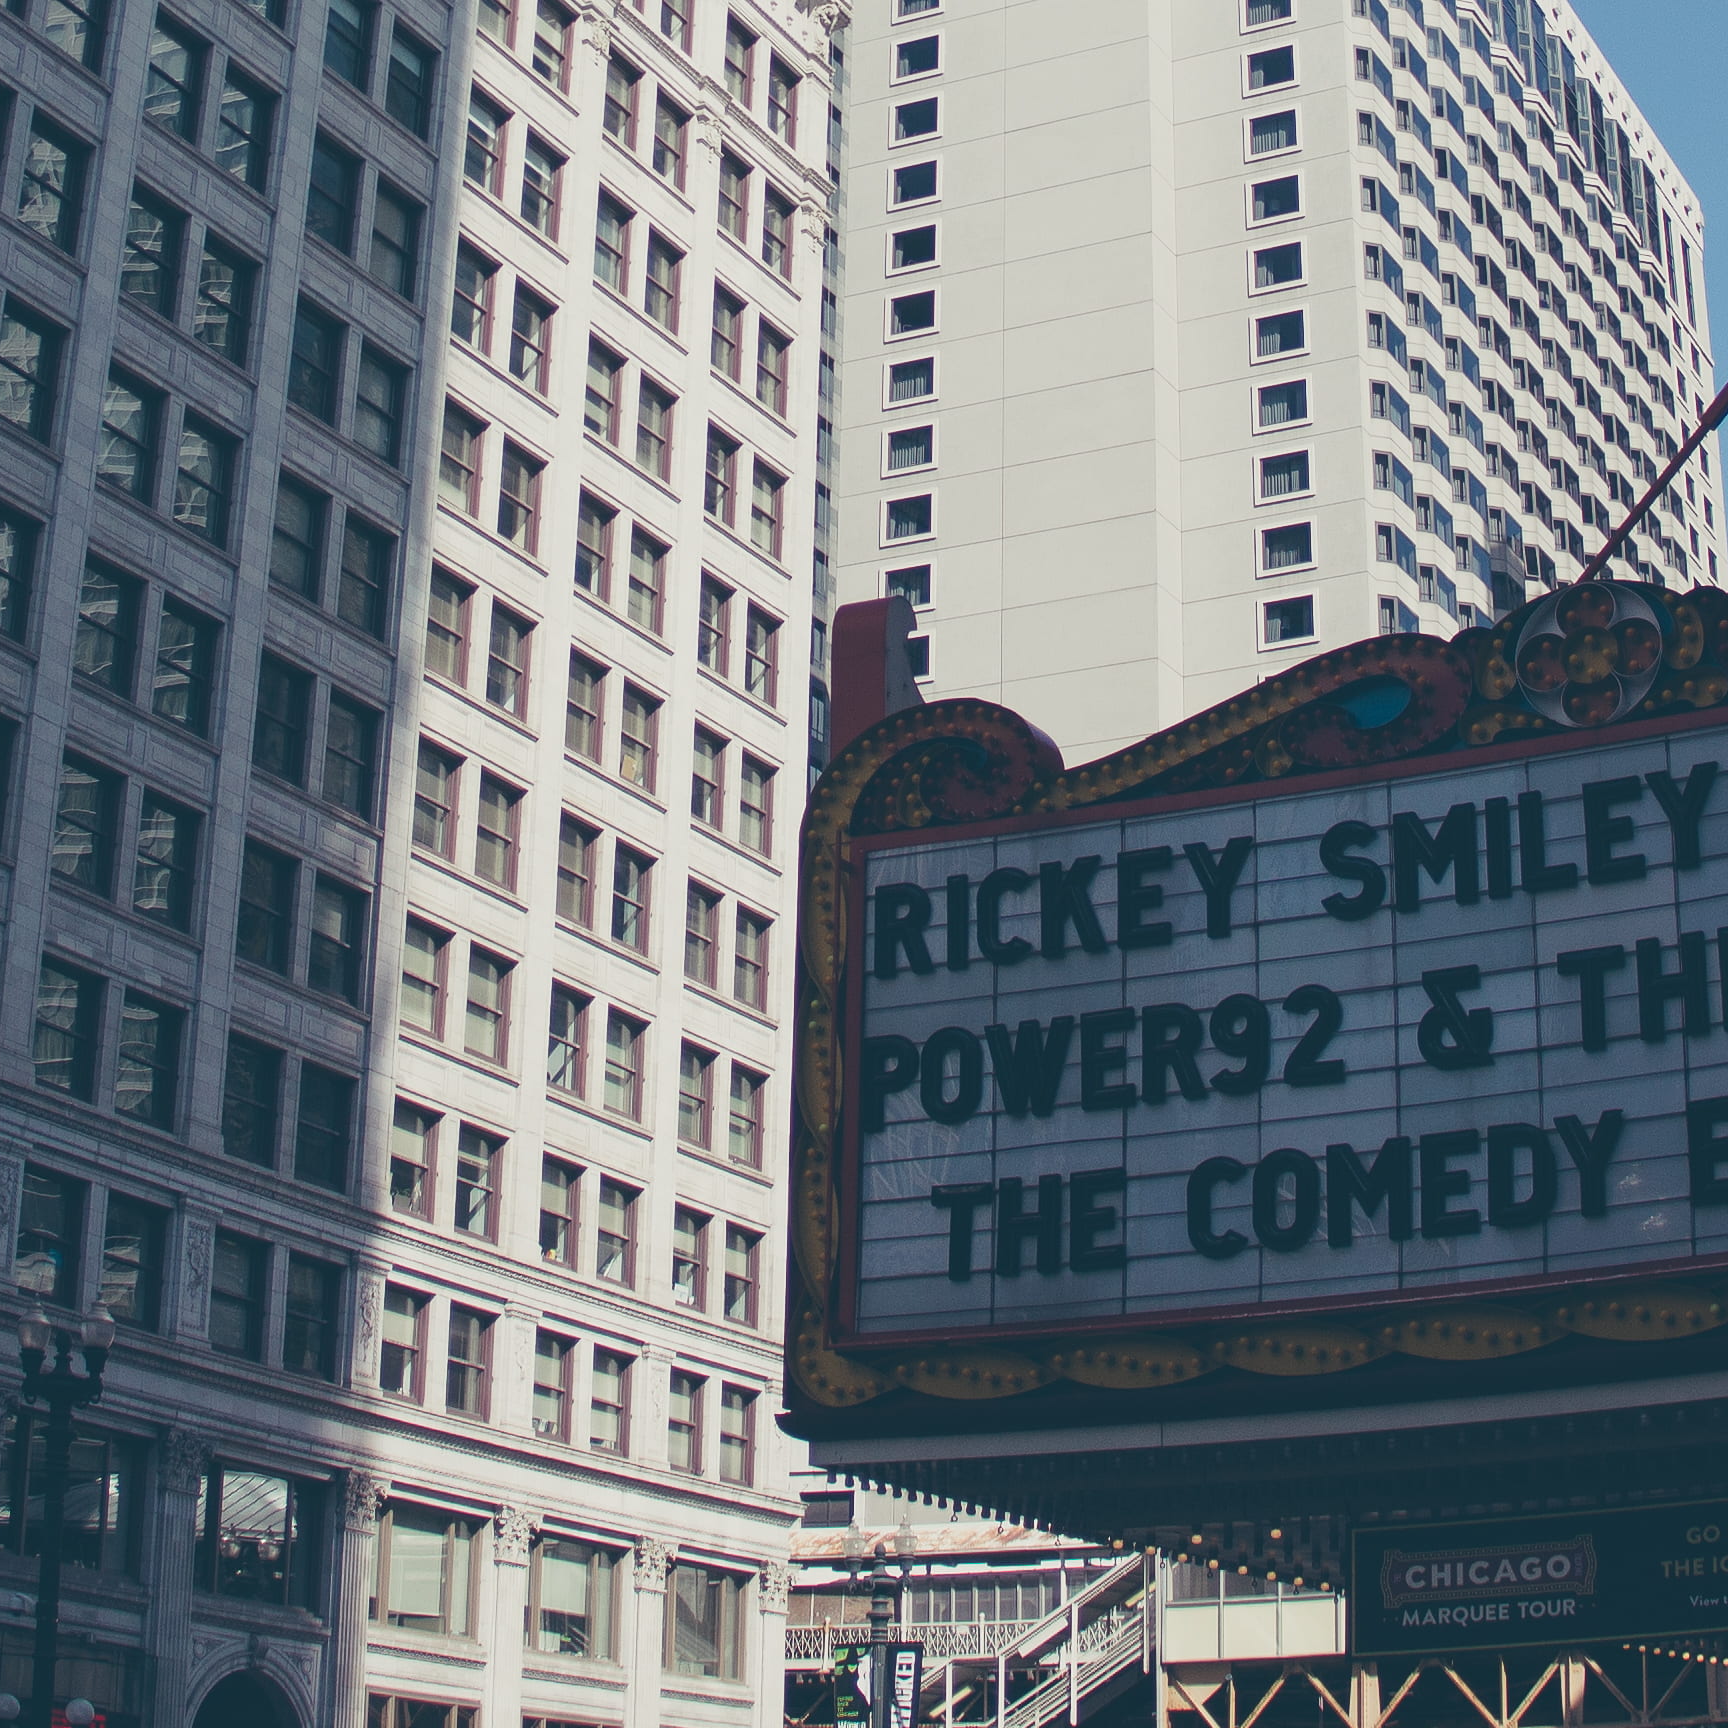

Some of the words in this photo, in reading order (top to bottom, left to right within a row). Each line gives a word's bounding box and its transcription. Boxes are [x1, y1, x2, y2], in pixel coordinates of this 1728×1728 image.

[872, 835, 1255, 980] RICKEY
[1320, 760, 1719, 921] SMILEY
[861, 983, 1347, 1134] POWER92
[1416, 965, 1494, 1068] &
[930, 1166, 1128, 1282] THE
[1185, 1108, 1623, 1260] COMEDY
[1686, 1524, 1721, 1546] GO
[1404, 1554, 1572, 1591] CHICAGO
[1660, 1558, 1706, 1580] THE
[1402, 1601, 1510, 1628] MARQUEE
[1517, 1598, 1577, 1620] TOUR
[1689, 1594, 1720, 1609] View
